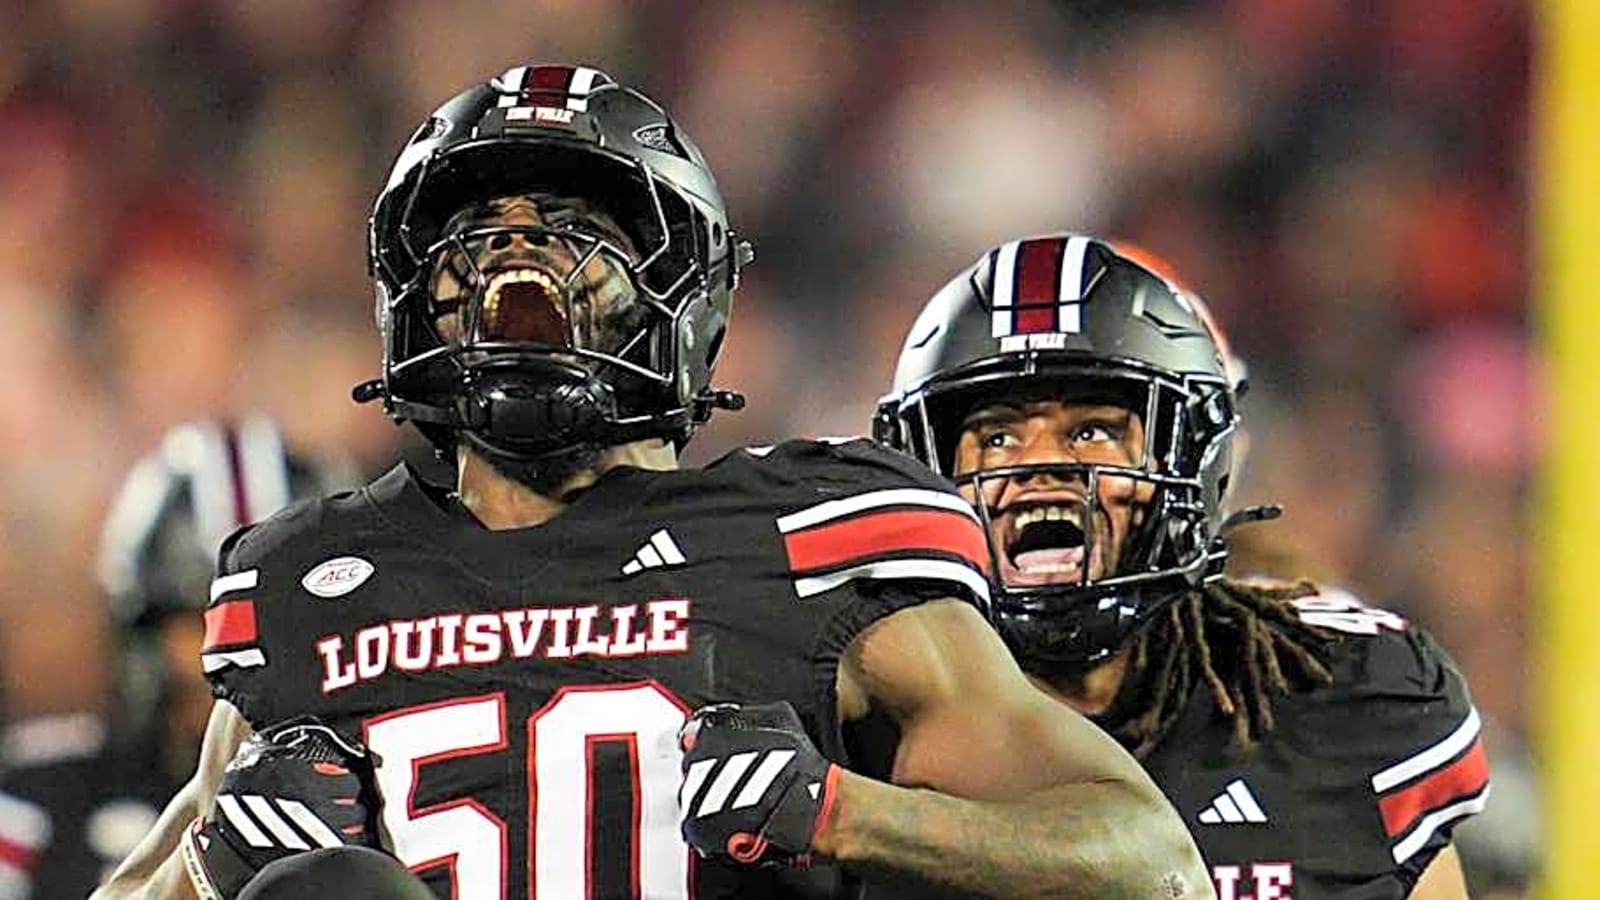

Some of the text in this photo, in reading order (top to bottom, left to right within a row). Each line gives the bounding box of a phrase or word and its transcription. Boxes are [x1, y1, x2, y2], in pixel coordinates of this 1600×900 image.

[316, 565, 362, 584] ACC
[317, 600, 691, 694] LOUISVILLE
[364, 680, 699, 900] 50
